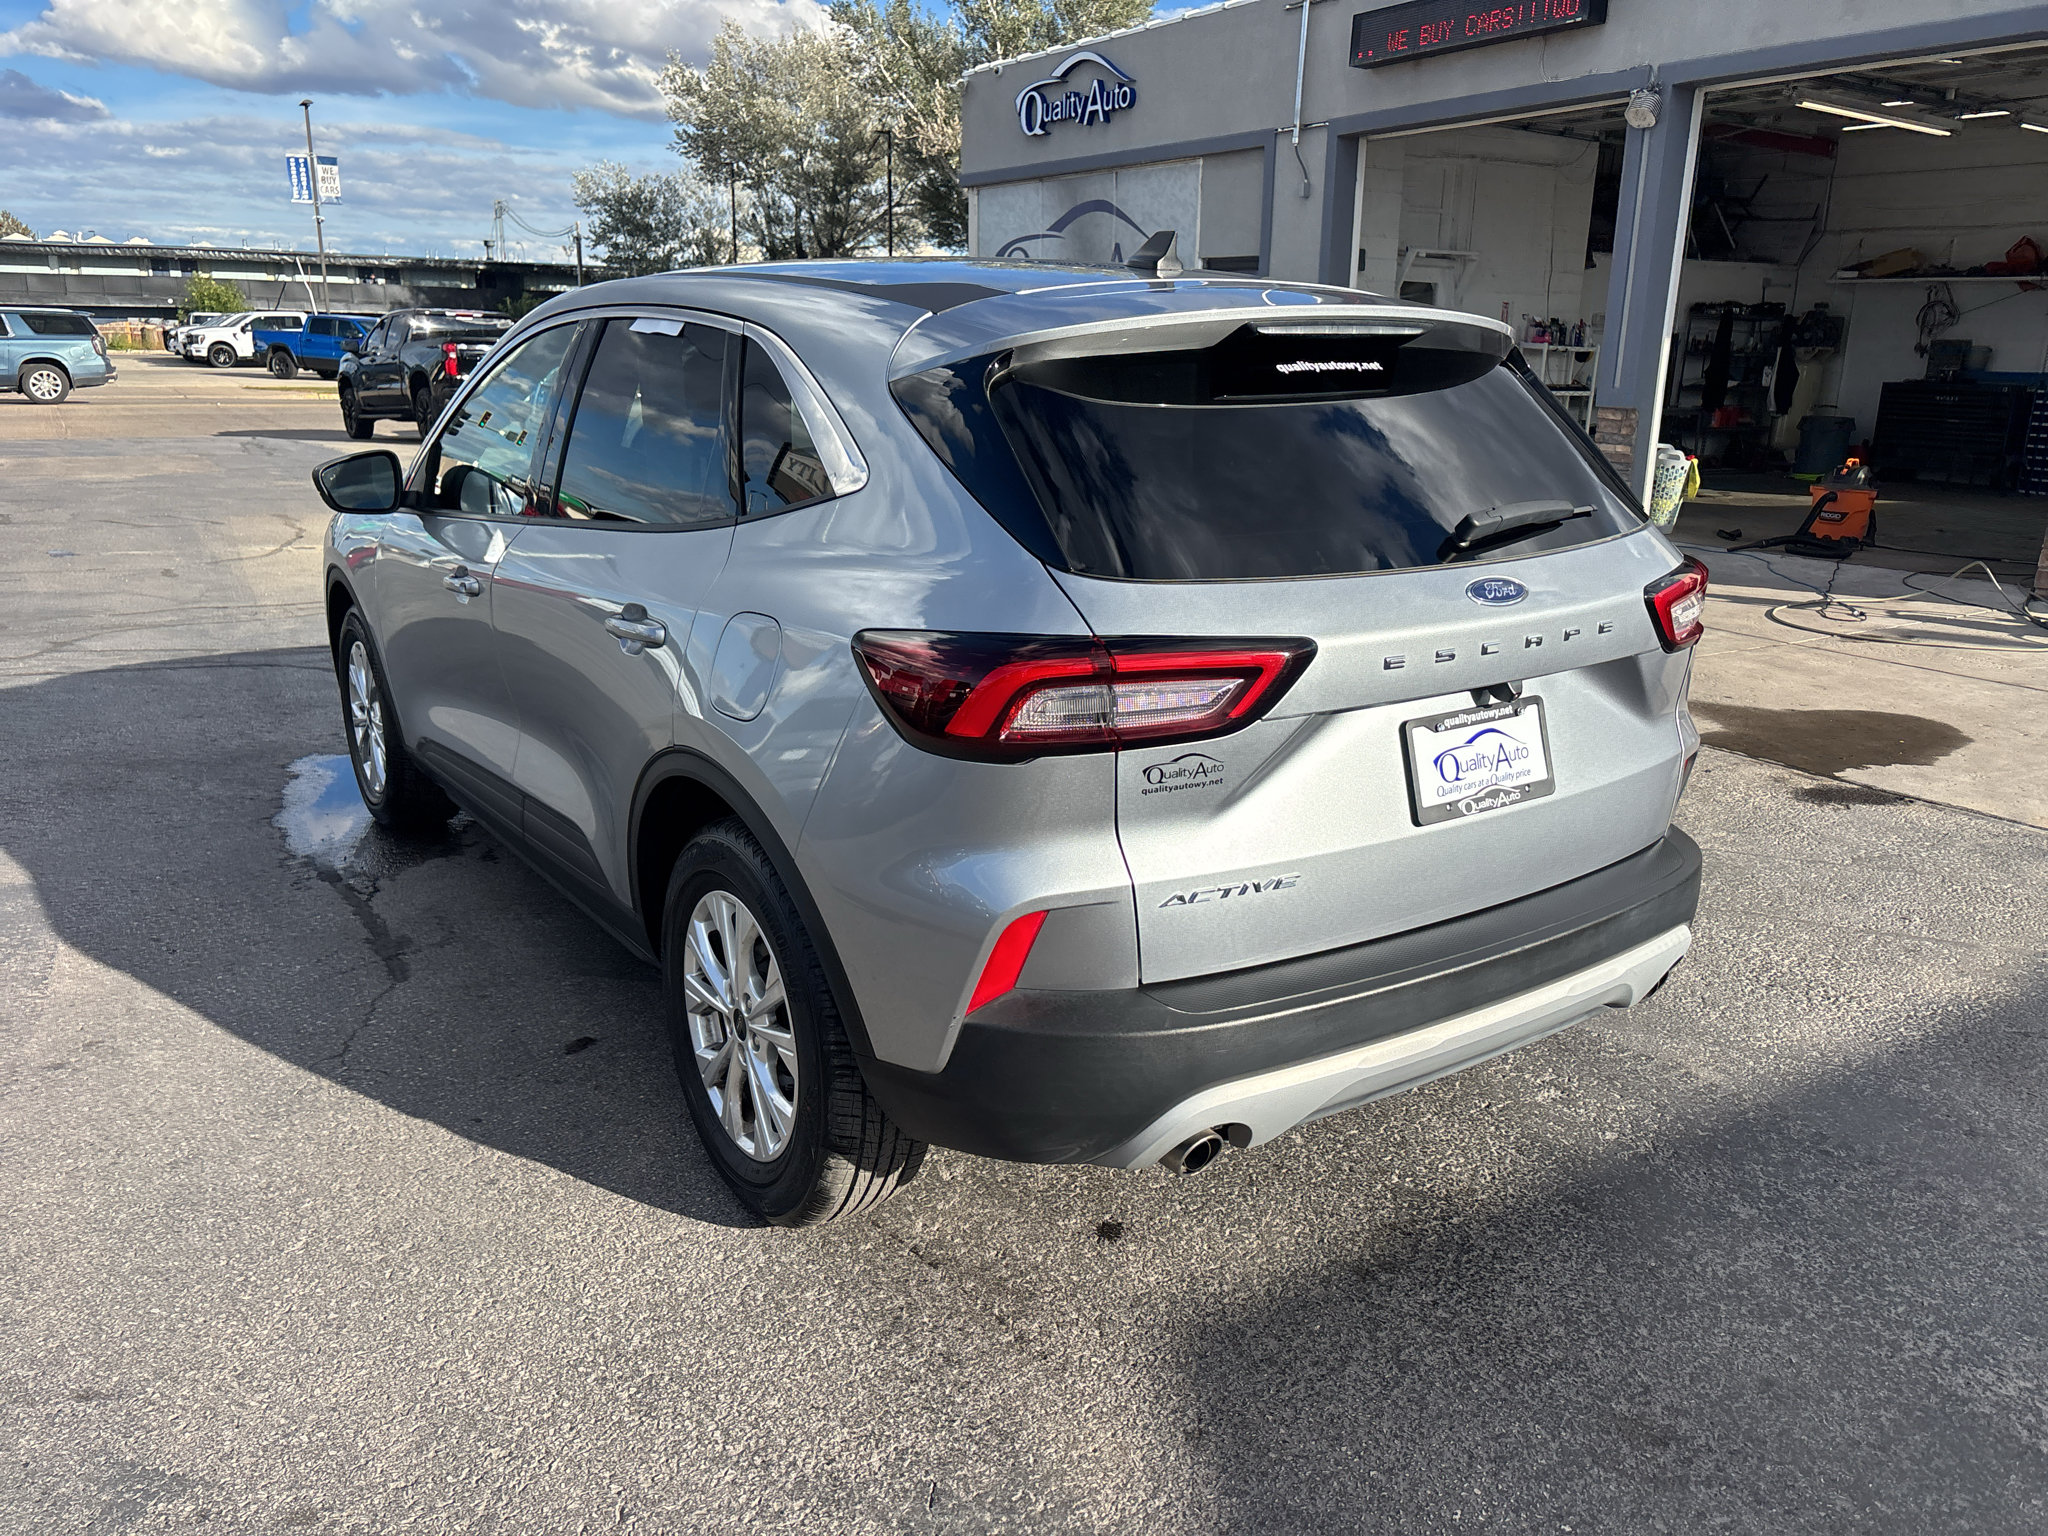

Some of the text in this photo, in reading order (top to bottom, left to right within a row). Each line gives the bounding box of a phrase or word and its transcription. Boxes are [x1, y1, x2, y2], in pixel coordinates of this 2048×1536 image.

[1387, 29, 1409, 52] WE
[1419, 19, 1455, 46] BUY
[320, 175, 337, 185] BUY
[321, 166, 335, 175] WE
[319, 185, 340, 195] CARS
[1484, 580, 1518, 599] Ford
[1383, 620, 1615, 671] ESCAPE
[1443, 704, 1514, 729] qualityautowy.net
[1141, 777, 1224, 796] qualityautowy.net
[1436, 784, 1464, 798] Quality
[1463, 782, 1478, 793] cars
[1477, 778, 1485, 788] at
[1490, 772, 1515, 785] Quality
[1515, 768, 1531, 780] price
[1158, 872, 1302, 909] ACTIVE
